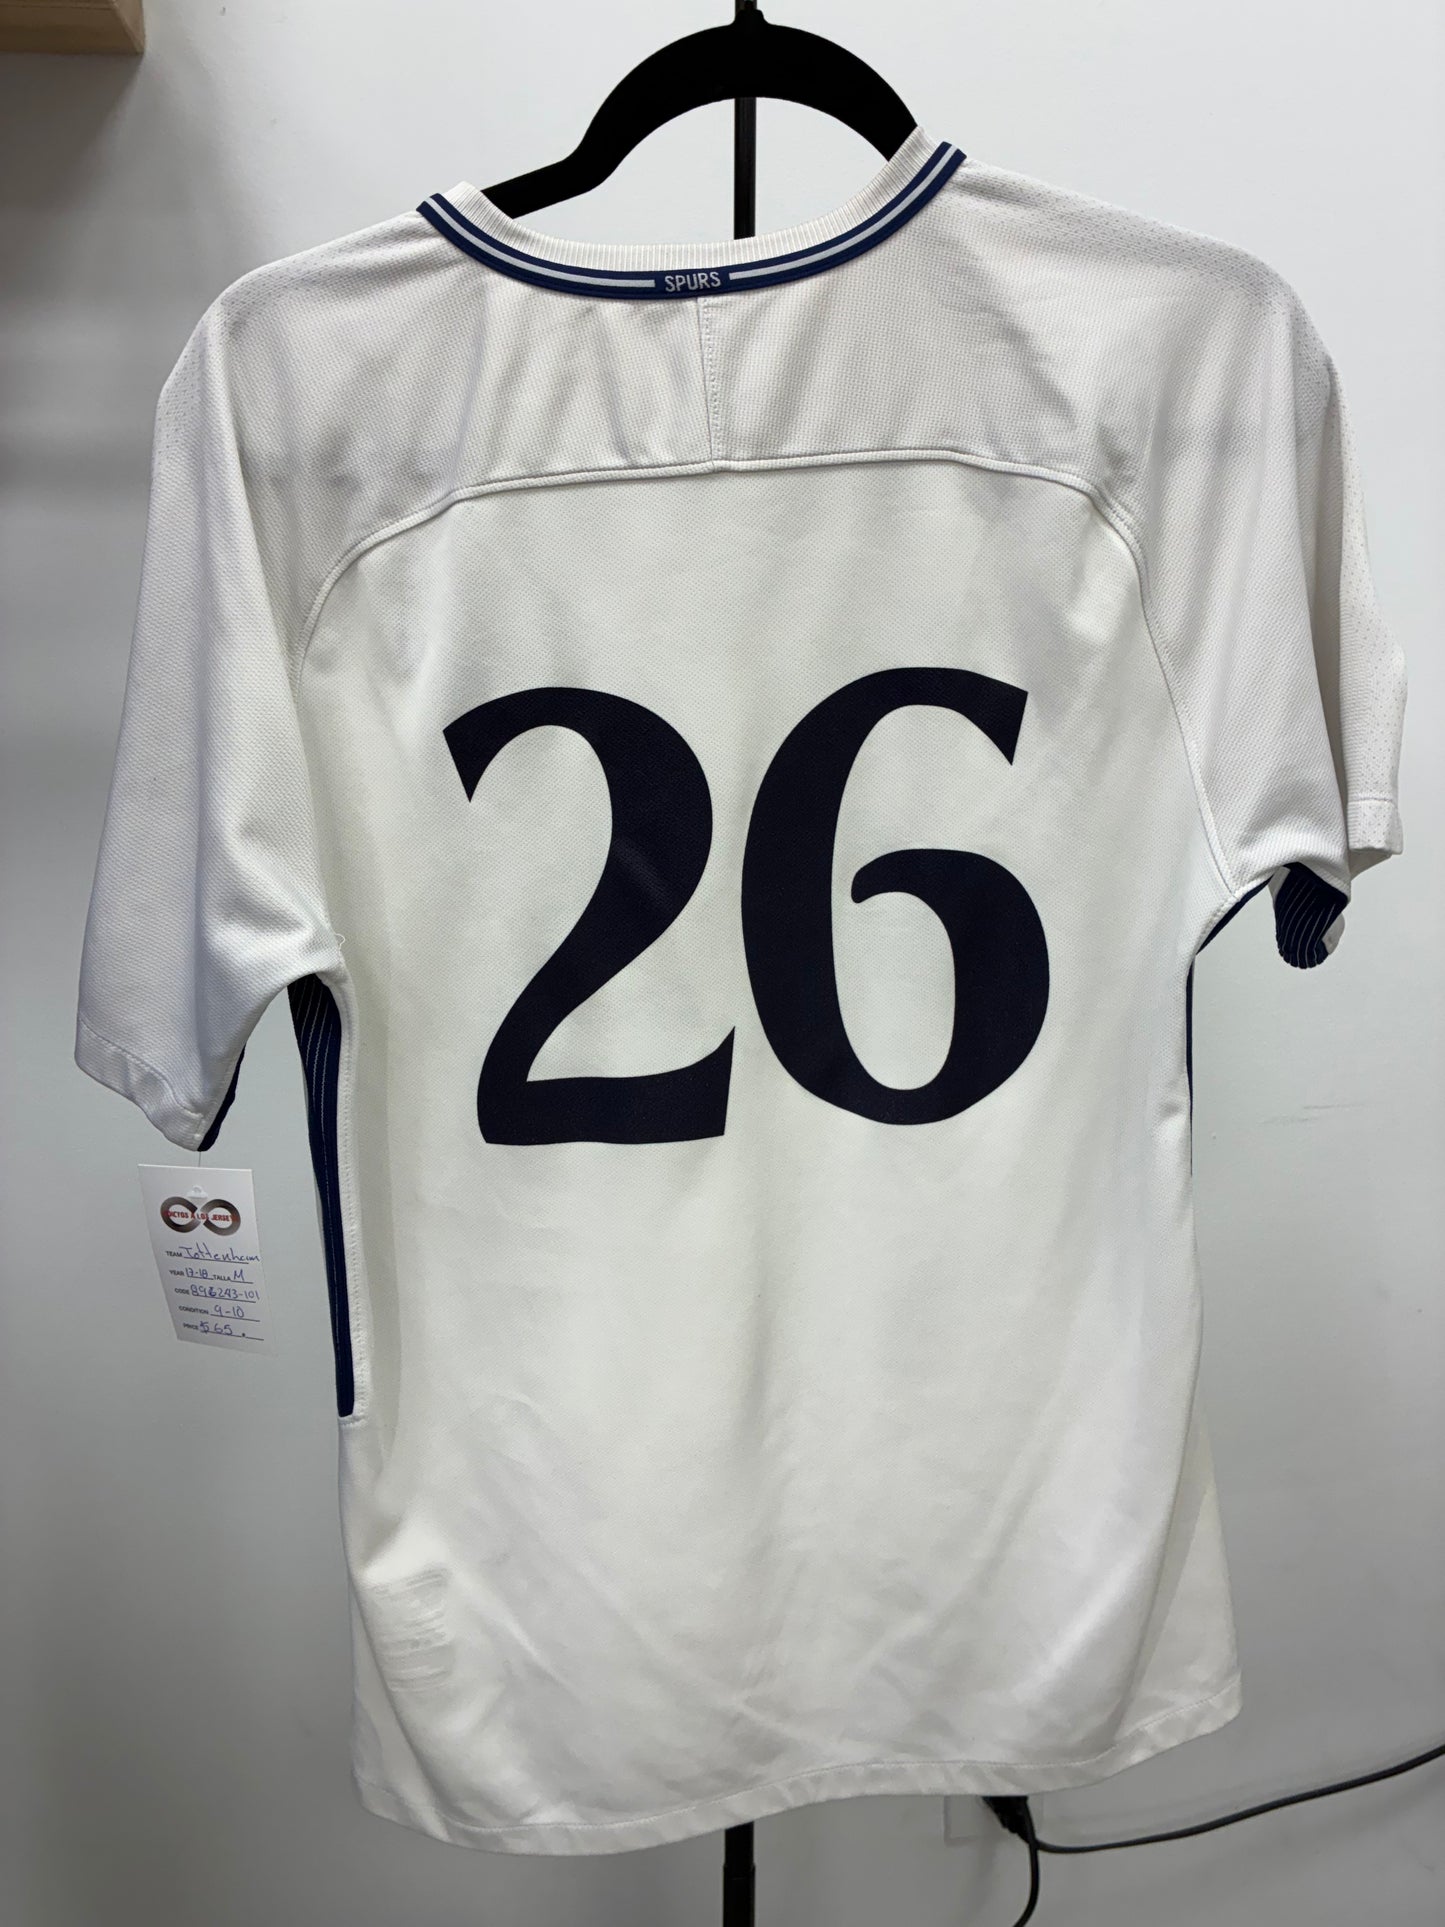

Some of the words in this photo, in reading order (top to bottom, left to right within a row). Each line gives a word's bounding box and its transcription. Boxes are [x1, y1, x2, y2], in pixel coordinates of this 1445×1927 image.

[664, 271, 721, 292] SPURS
[443, 667, 1050, 1147] 26
[169, 1269, 185, 1277] YEAR
[234, 1268, 245, 1282] M
[178, 1305, 209, 1315] CONDITION
